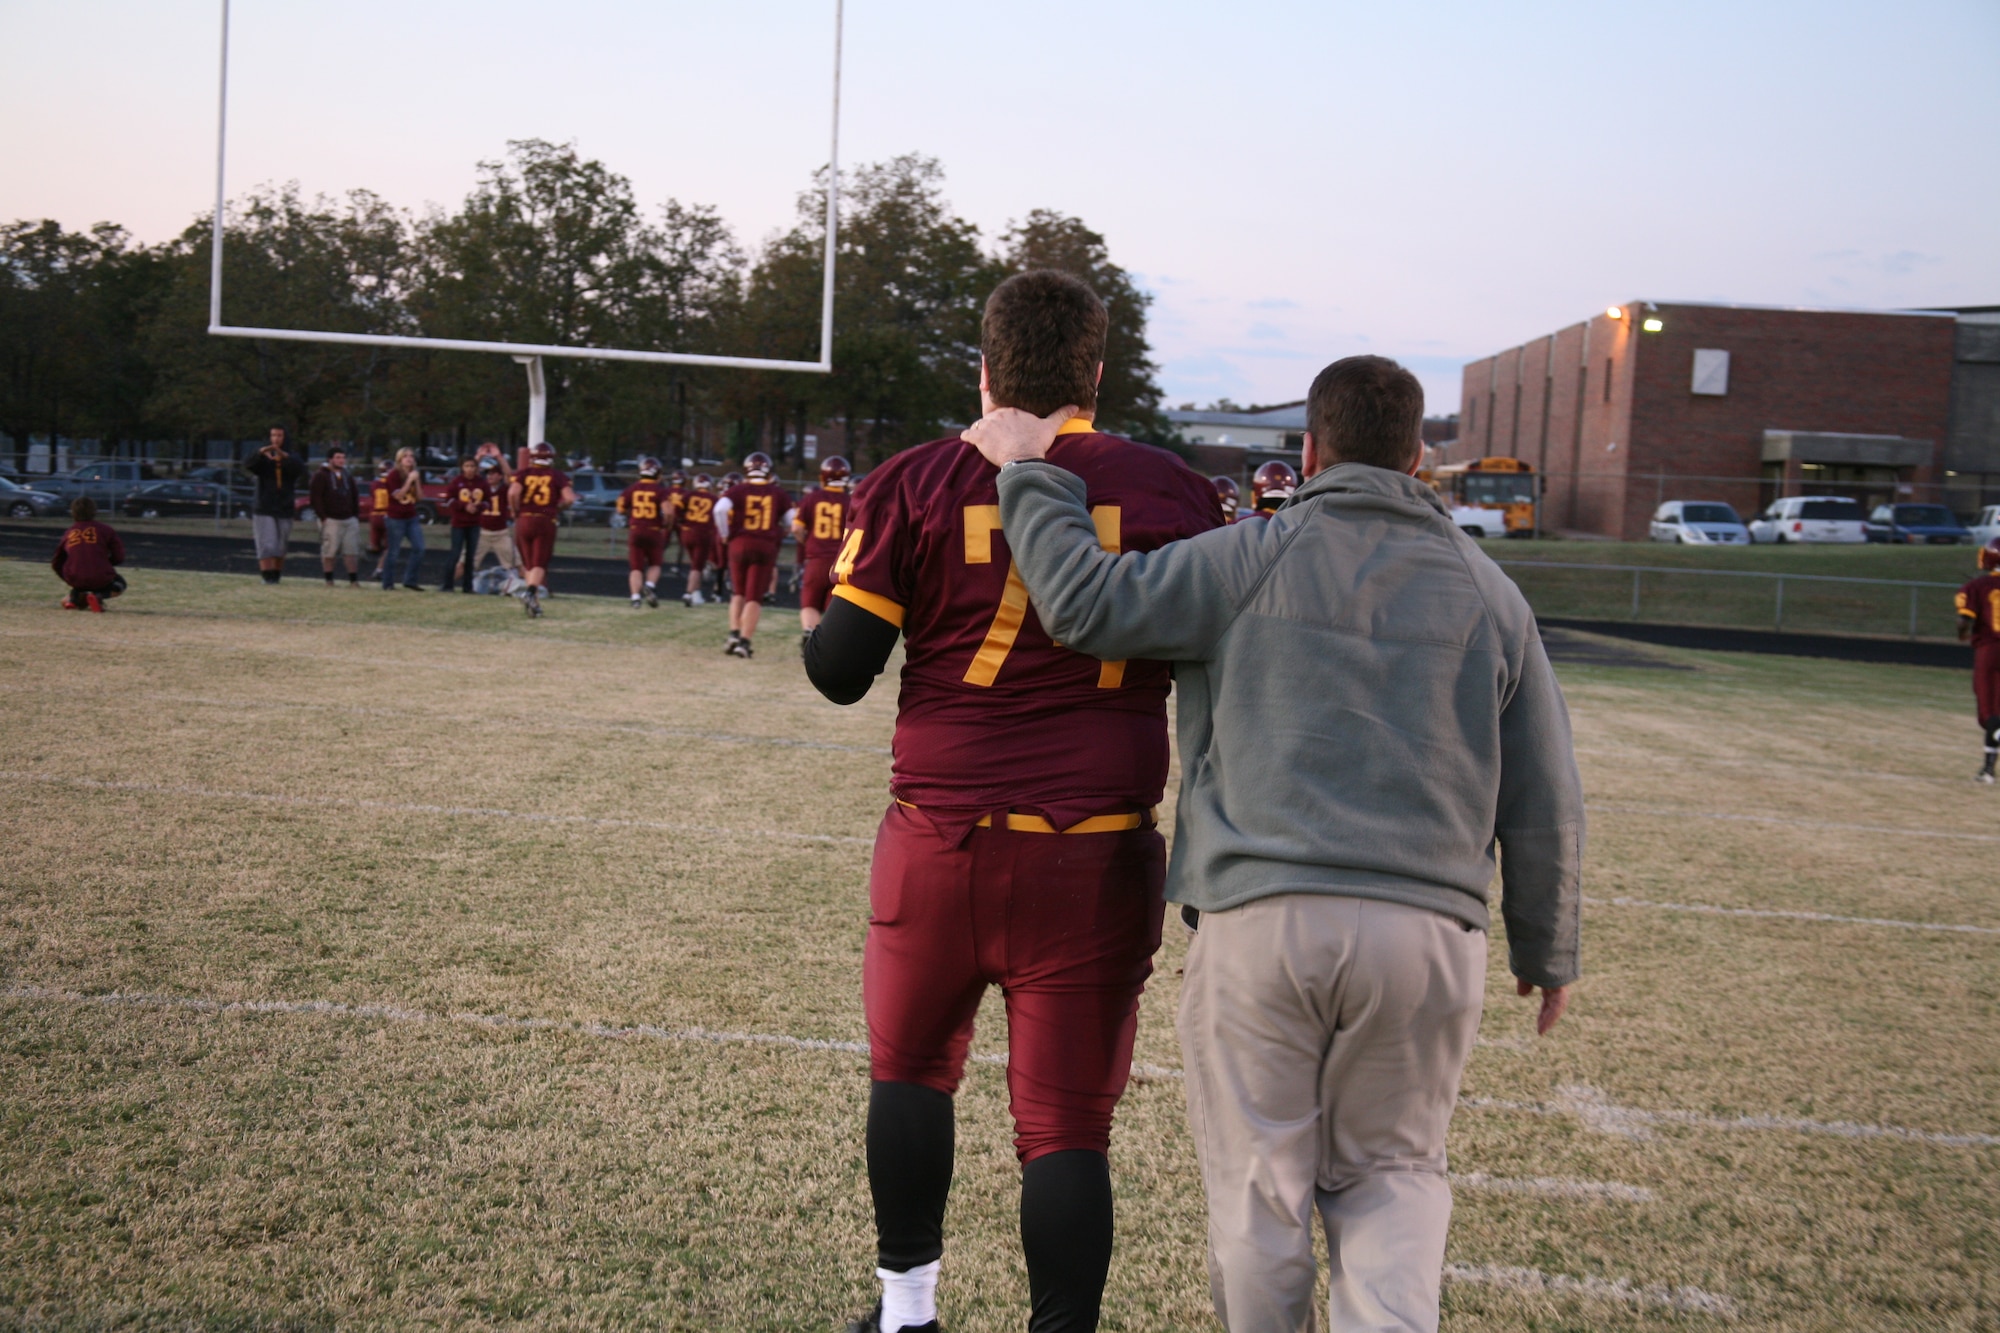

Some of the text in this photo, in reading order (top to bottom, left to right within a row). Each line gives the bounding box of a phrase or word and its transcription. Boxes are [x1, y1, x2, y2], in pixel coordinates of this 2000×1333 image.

[524, 475, 552, 506] 73
[632, 490, 657, 519] 55
[686, 496, 712, 522] 52
[744, 495, 772, 530] 51
[814, 502, 842, 539] 61
[67, 527, 97, 547] 24
[836, 528, 864, 585] 4
